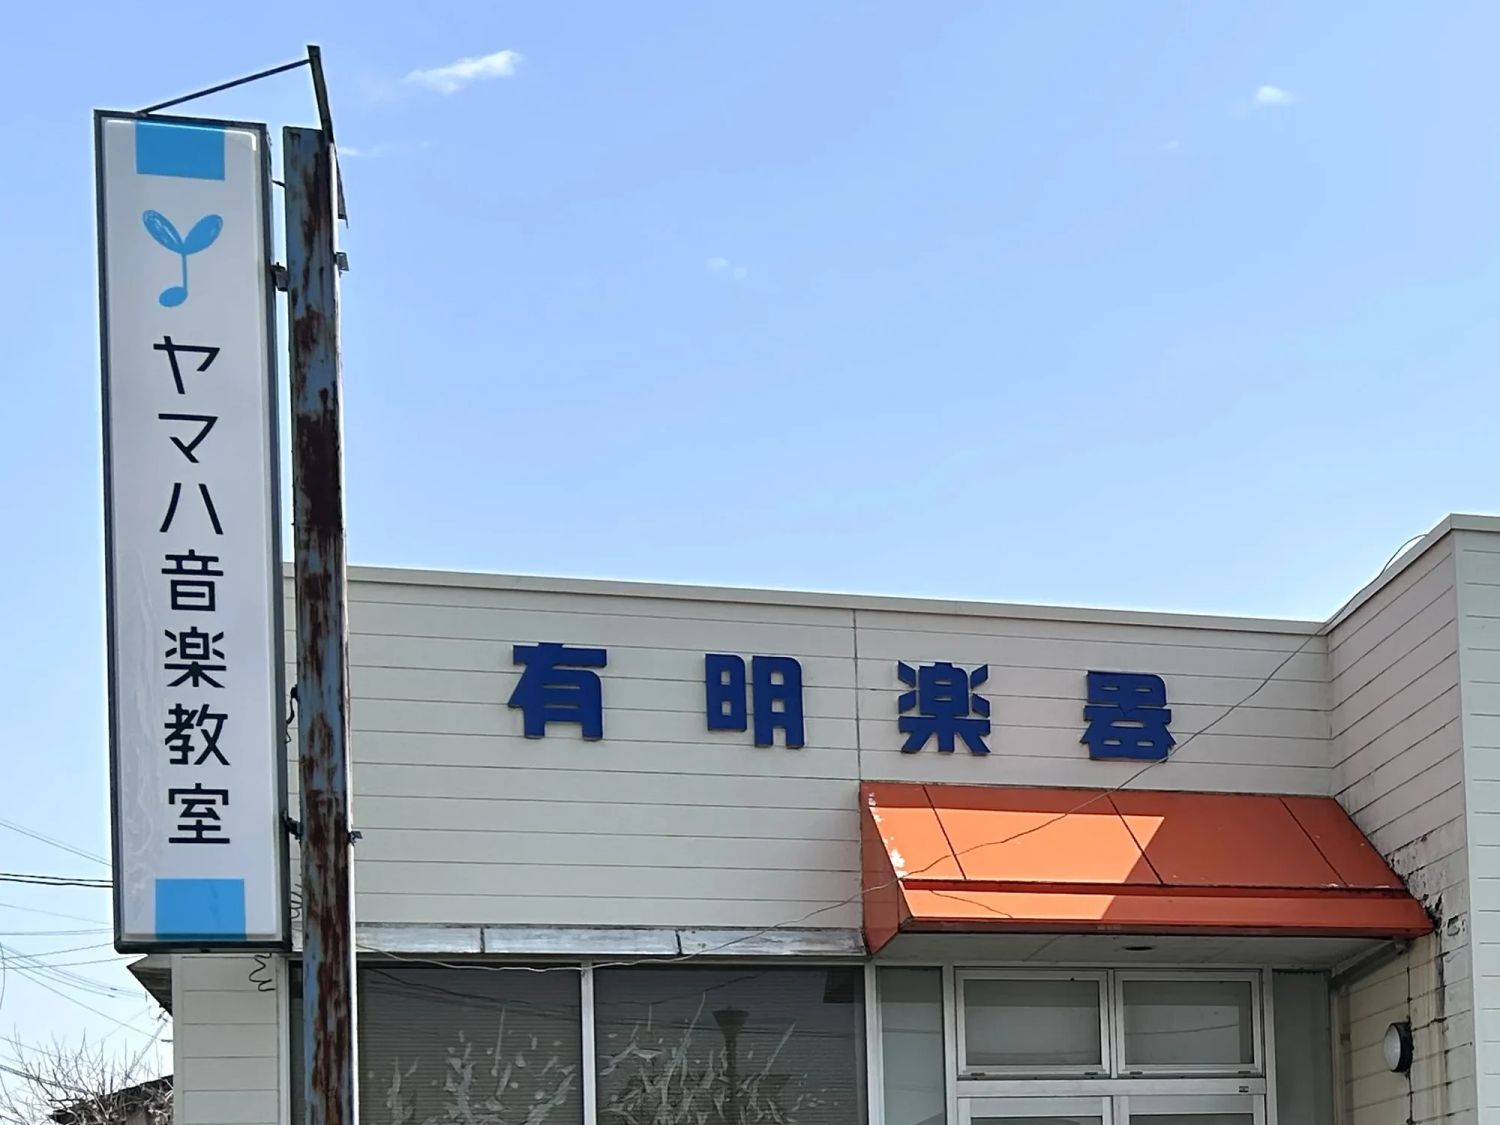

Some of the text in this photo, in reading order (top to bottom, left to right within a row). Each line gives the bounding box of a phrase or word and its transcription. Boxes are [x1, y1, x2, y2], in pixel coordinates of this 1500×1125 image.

[152, 334, 231, 844] ヤマハ音楽教室
